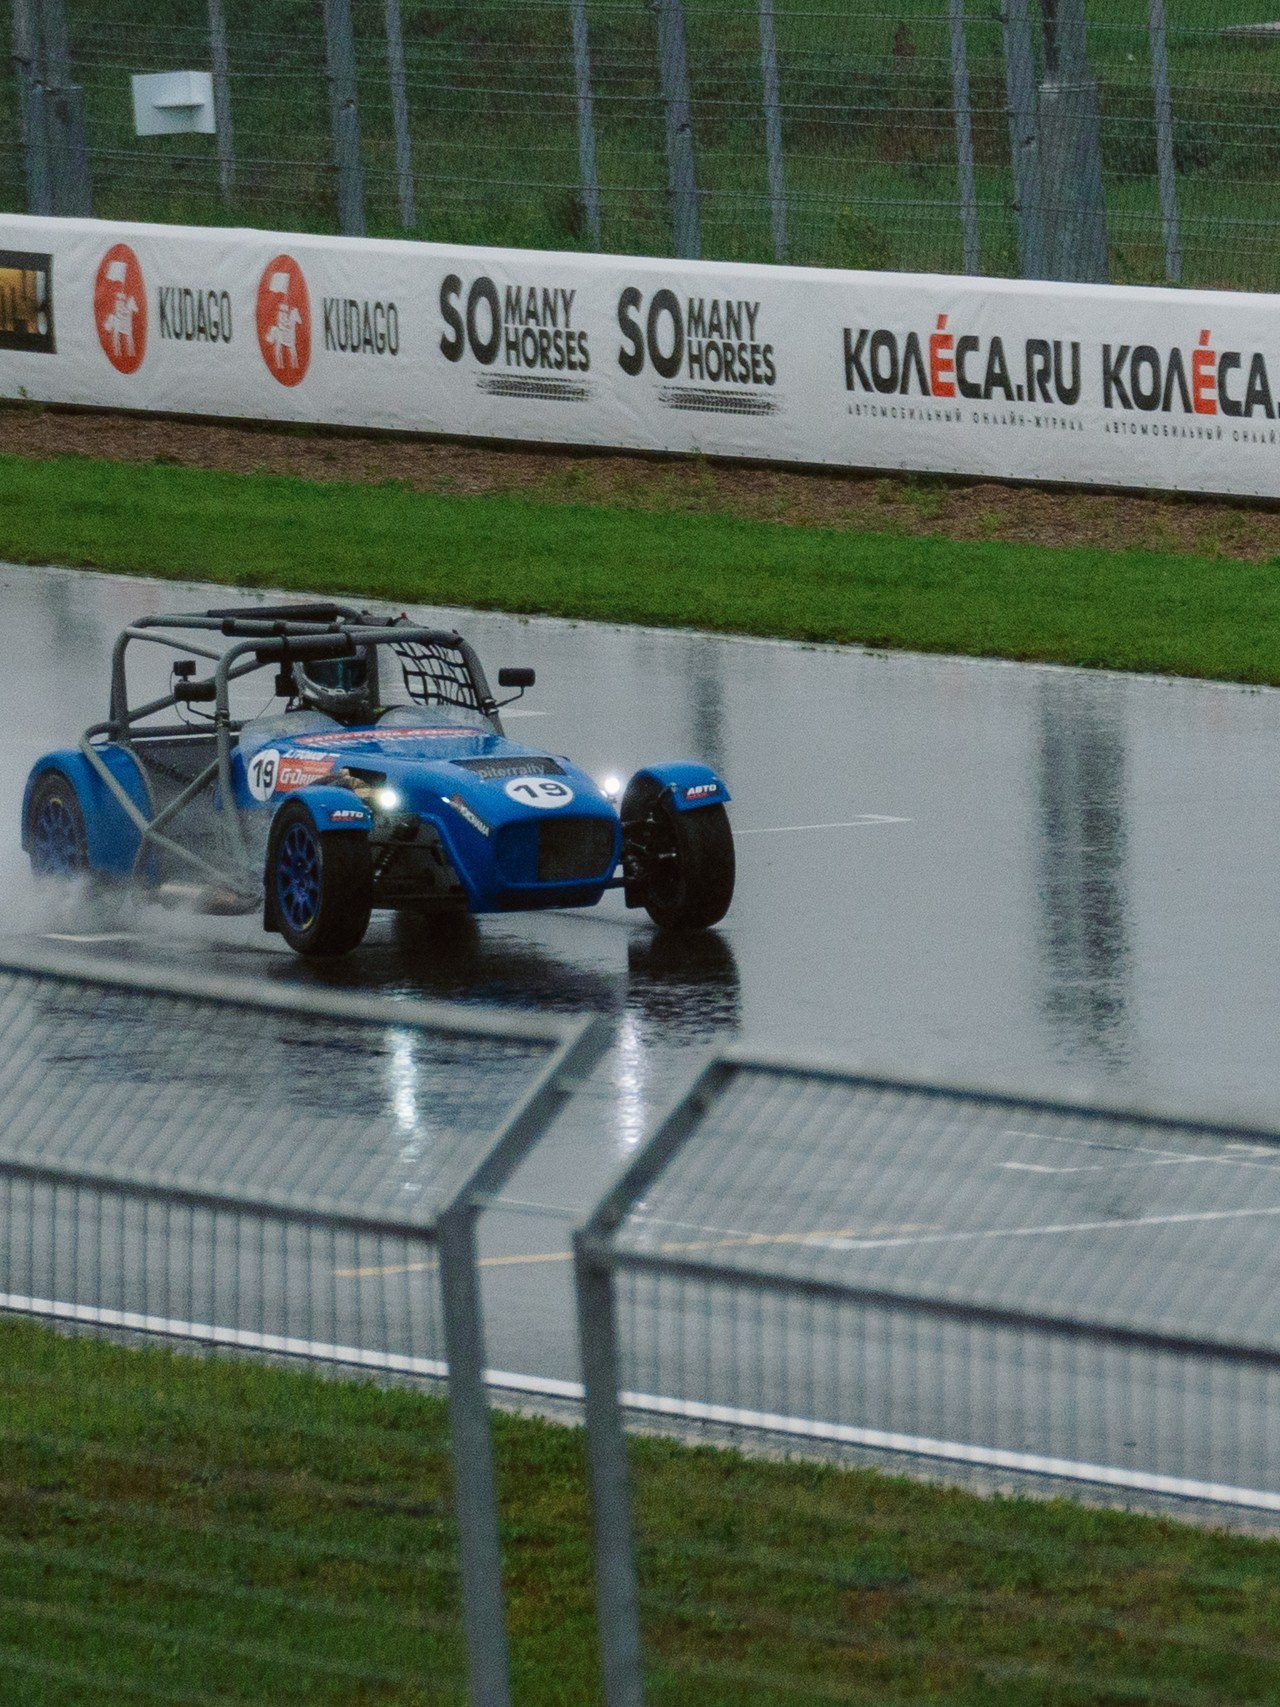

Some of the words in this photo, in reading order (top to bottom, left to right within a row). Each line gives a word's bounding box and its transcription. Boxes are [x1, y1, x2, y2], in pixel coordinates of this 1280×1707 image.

[158, 286, 233, 344] KUDAGO
[324, 298, 400, 356] KUDAGO
[439, 273, 502, 366] SO
[504, 285, 577, 329] MANY
[619, 286, 684, 379] SO
[687, 297, 761, 342] MANY
[504, 326, 591, 372] HORSES
[687, 339, 778, 386] HORSES
[1232, 429, 1280, 445] ОНЛАЙ
[252, 758, 275, 788] 19
[478, 763, 545, 779] piterrally
[513, 782, 568, 799] 19
